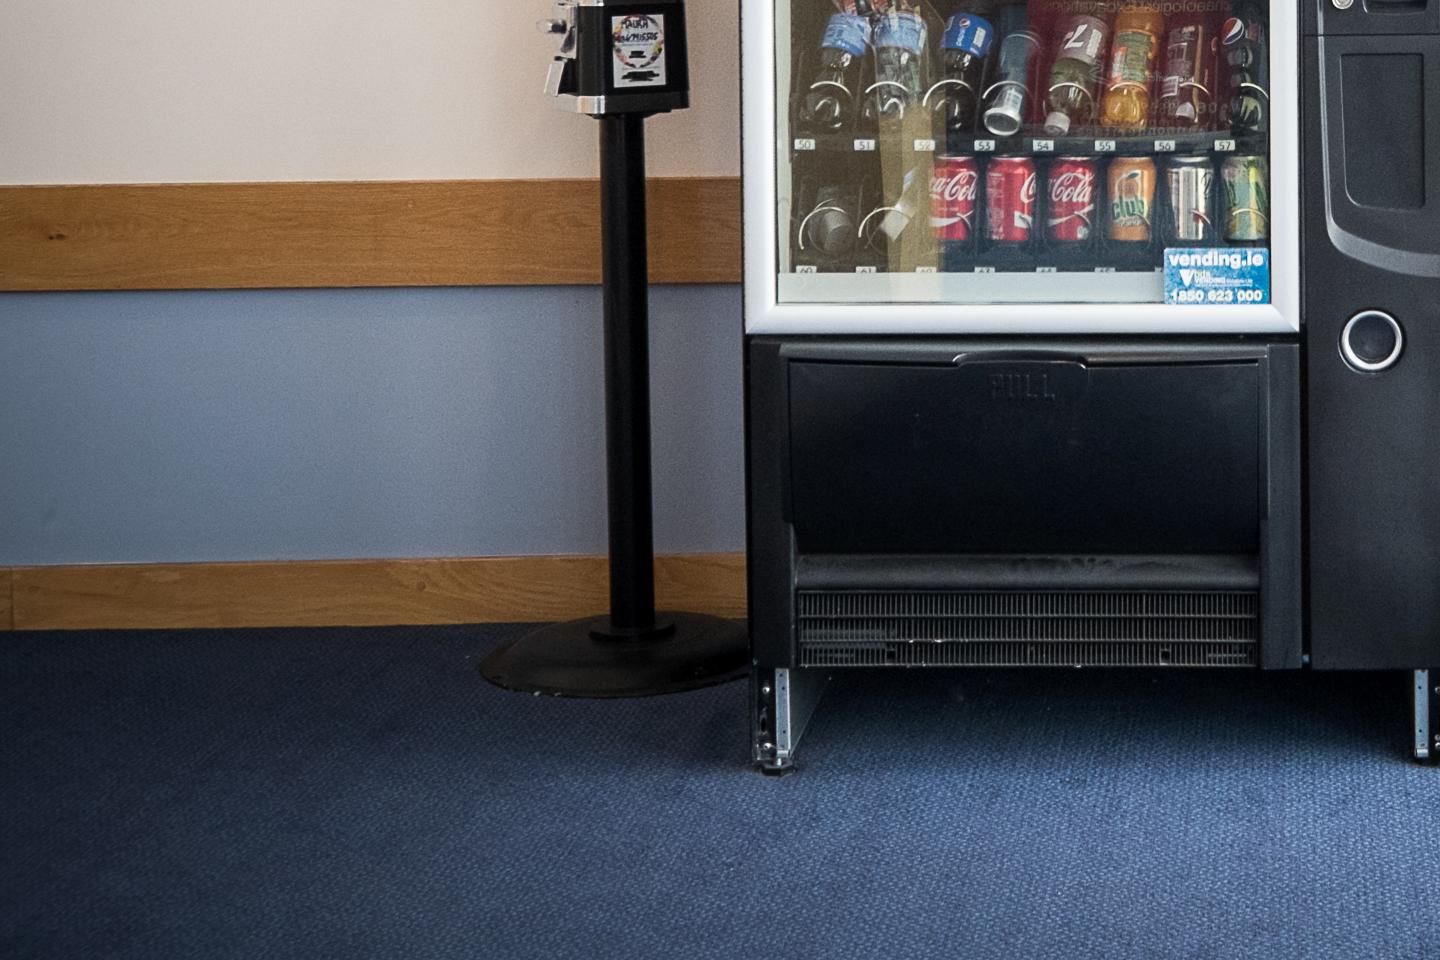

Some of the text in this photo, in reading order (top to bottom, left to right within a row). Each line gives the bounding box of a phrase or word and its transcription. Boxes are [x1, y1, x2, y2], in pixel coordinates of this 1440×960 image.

[1112, 194, 1146, 219] club
[1169, 249, 1264, 269] vending.ie
[1170, 290, 1262, 301] 1850 623 000
